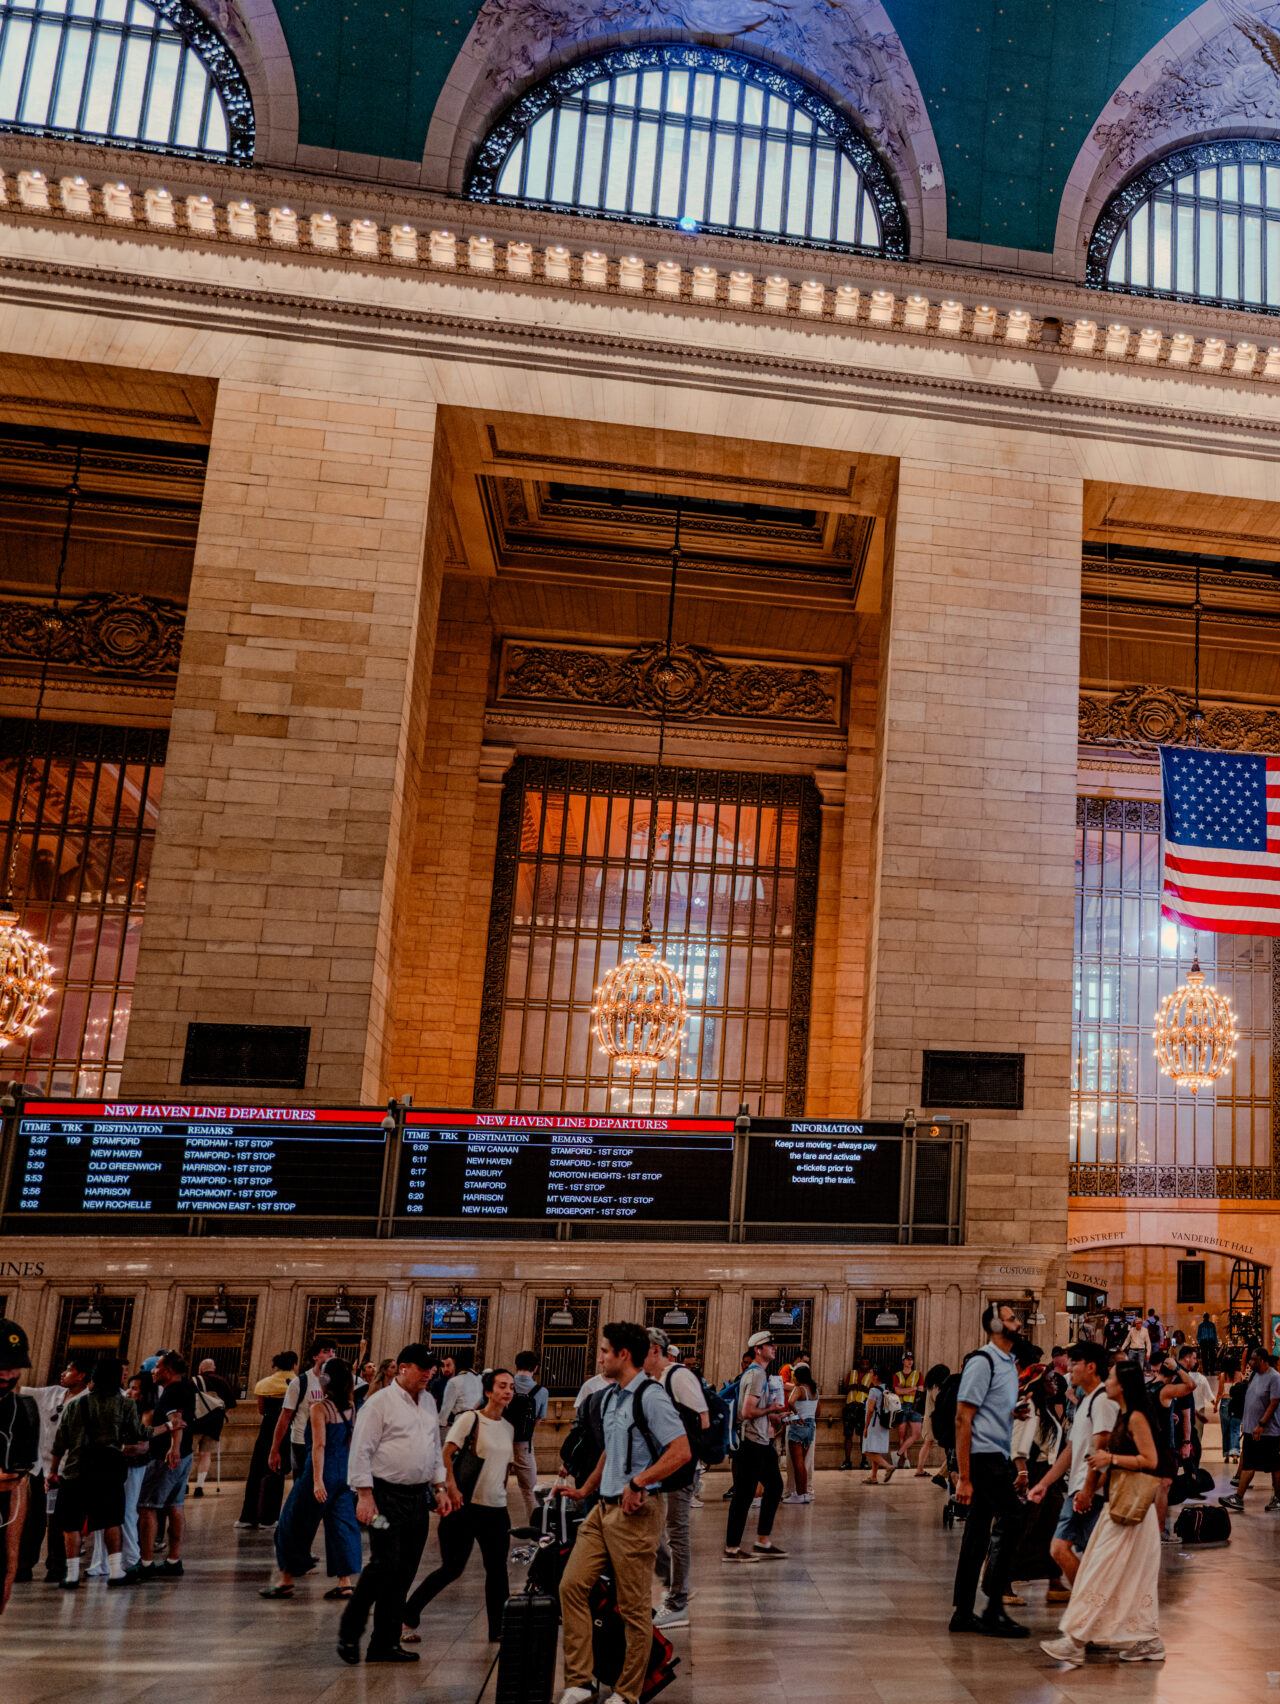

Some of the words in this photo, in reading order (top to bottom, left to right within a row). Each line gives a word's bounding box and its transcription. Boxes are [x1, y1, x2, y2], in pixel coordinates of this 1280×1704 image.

[104, 1105, 137, 1117] NEW
[141, 1106, 190, 1118] HAVEN
[194, 1107, 226, 1118] LINE
[230, 1109, 316, 1120] DEPARTURES
[476, 1116, 506, 1126] NEW
[510, 1117, 553, 1127] HAVEN
[557, 1118, 585, 1128] LINE
[589, 1119, 668, 1130] DEPARTURES
[791, 1124, 863, 1133] INFORMATION
[25, 1123, 50, 1132] TIME
[62, 1124, 83, 1132] TRK
[94, 1124, 163, 1134] DESTINATION
[188, 1126, 233, 1135] REMARKS
[31, 1135, 49, 1144] 5:37
[66, 1136, 81, 1144] 109
[92, 1137, 140, 1145] STAMFORD
[186, 1138, 228, 1147] FORDHAM
[235, 1139, 248, 1148] 1ST
[251, 1139, 273, 1148] STOP
[406, 1131, 430, 1140] TIME
[440, 1132, 458, 1140] TRK
[468, 1133, 530, 1142] DESTINATION
[552, 1135, 593, 1144] REMARKS
[467, 1145, 486, 1153] NEW
[487, 1145, 519, 1154] CANAAN
[551, 1147, 591, 1156] STAMFORD
[613, 1148, 633, 1156] STOP
[775, 1140, 794, 1149] Keep
[806, 1141, 832, 1150] moving
[838, 1142, 862, 1151] always
[91, 1149, 111, 1158] NEW
[113, 1149, 142, 1158] HAVEN
[184, 1151, 230, 1160] STAMFORD
[237, 1152, 251, 1160] 1ST
[253, 1152, 275, 1160] STOP
[790, 1152, 801, 1160] the
[27, 1161, 45, 1169] 5:50
[89, 1162, 107, 1170] OLD
[109, 1162, 162, 1171] GREENWICH
[182, 1163, 229, 1172] HARRISON
[233, 1164, 247, 1173] 1ST
[249, 1164, 272, 1173] STOP
[550, 1159, 591, 1167] STAMFORD
[465, 1169, 502, 1177] DANBURY
[828, 1165, 844, 1173] prior
[25, 1174, 43, 1183] 5:53
[87, 1174, 130, 1183] DANBURY
[181, 1176, 230, 1185] STAMFORD
[234, 1177, 248, 1185] 1ST
[250, 1177, 272, 1185] STOP
[464, 1181, 506, 1189] STAMFORD
[792, 1176, 825, 1184] boarding
[85, 1187, 131, 1196] HARRISON
[179, 1188, 235, 1197] LARCHMONT
[239, 1189, 253, 1198] 1ST
[255, 1190, 277, 1198] STOP
[20, 1200, 39, 1208] 6:02
[83, 1200, 104, 1209] NEW
[105, 1200, 152, 1209] ROCHELLE
[177, 1201, 189, 1209] MT
[192, 1201, 227, 1210] VERNON
[229, 1202, 250, 1210] EAST
[258, 1202, 271, 1211] 1ST
[274, 1202, 296, 1211] STOP
[1090, 1232, 1125, 1242] STREET
[1171, 1232, 1230, 1248] VANDERBILT
[1231, 1242, 1254, 1255] HALL
[1083, 1273, 1108, 1287] TAXIS
